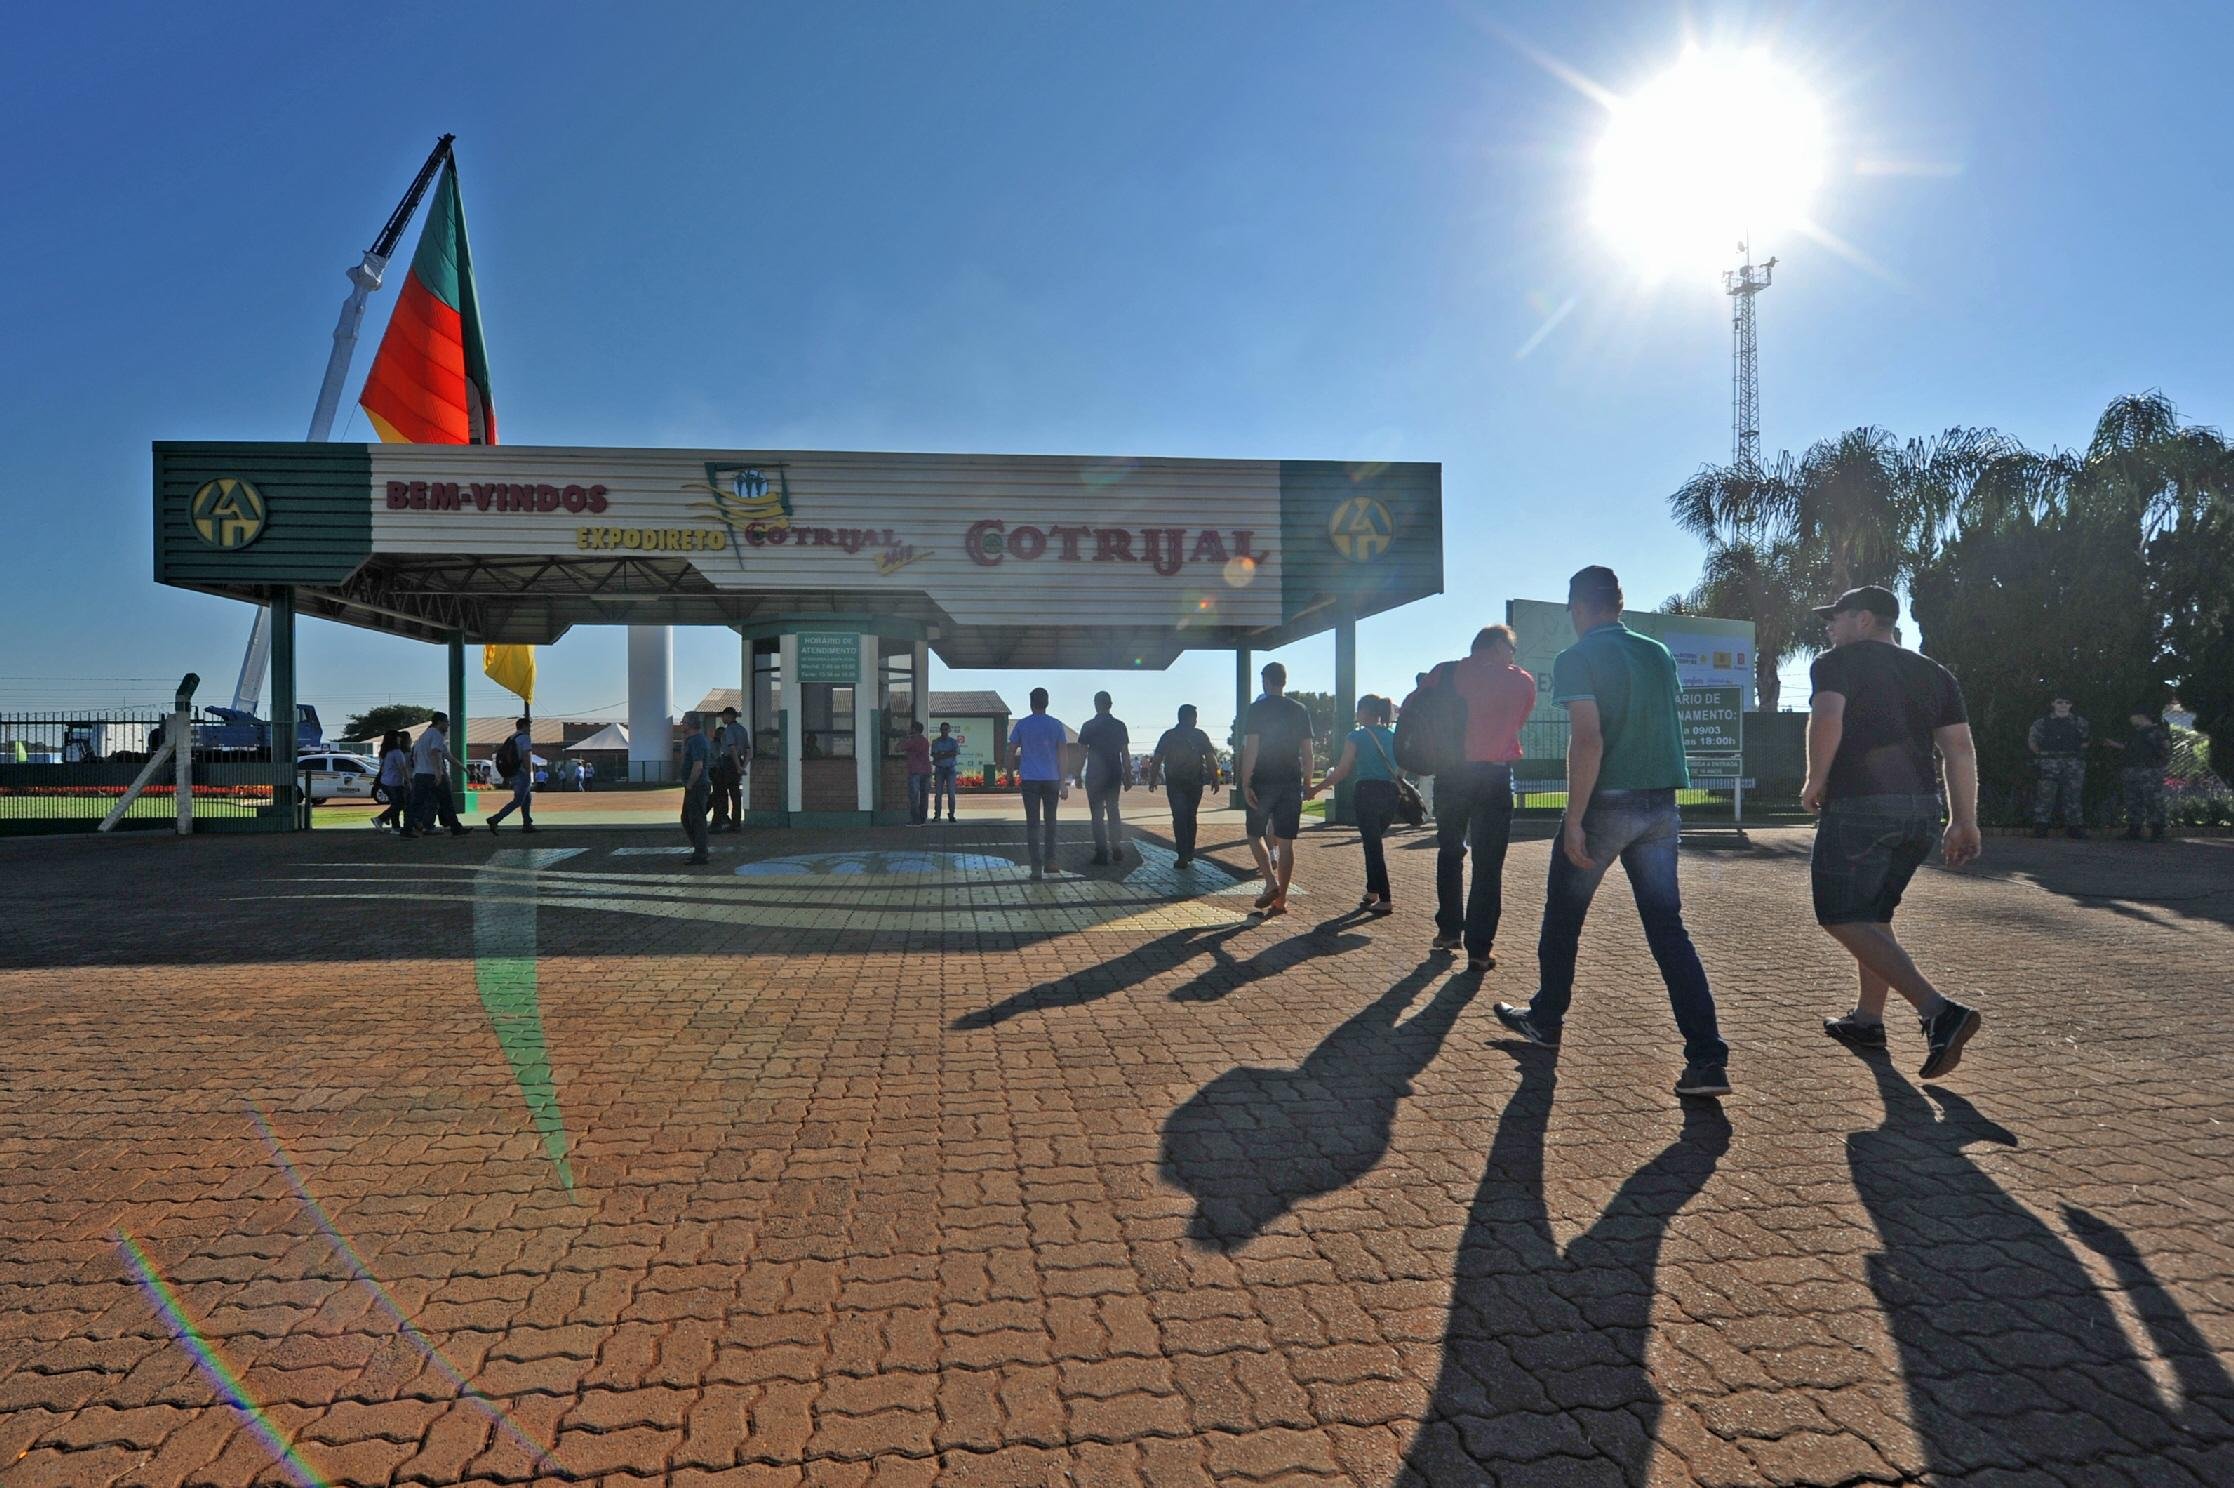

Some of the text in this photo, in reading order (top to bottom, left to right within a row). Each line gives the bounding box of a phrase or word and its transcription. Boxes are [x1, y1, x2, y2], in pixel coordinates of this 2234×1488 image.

[386, 481, 608, 513] BEM-VINDOS
[577, 522, 902, 555] EXPODIRETO COTRIJAL
[965, 518, 1269, 576] COTRIJAL
[801, 647, 857, 655] ATENDIMENTO
[1674, 693, 1721, 705] ARIO DE
[1677, 708, 1737, 721] NAMENTO:
[1693, 726, 1721, 735] 09/03
[1701, 736, 1737, 745] 18:00h
